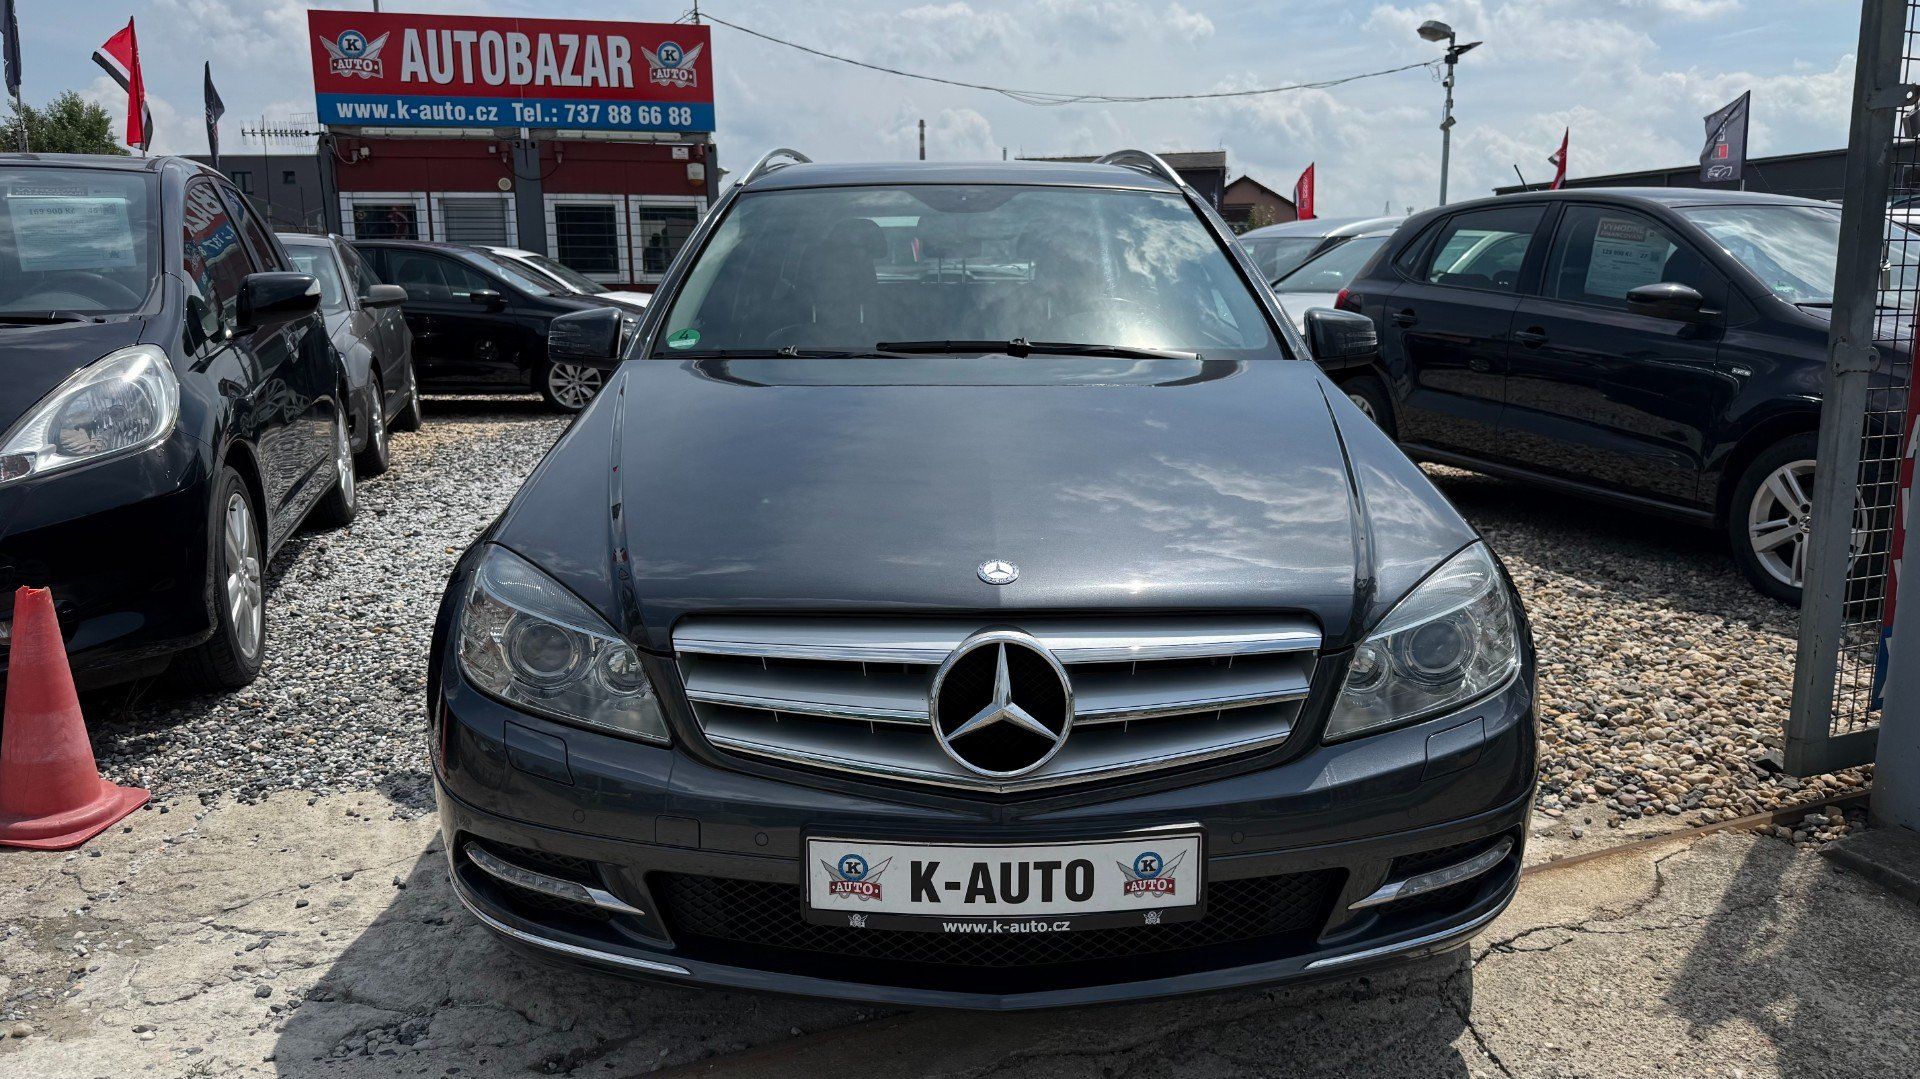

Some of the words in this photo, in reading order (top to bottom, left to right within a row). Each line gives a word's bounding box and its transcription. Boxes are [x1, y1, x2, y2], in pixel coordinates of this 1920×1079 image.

[345, 39, 359, 51] K
[401, 28, 634, 88] AUTOBAZAR
[663, 50, 677, 61] K
[337, 59, 373, 72] AUTO
[656, 68, 688, 81] AUTO
[336, 100, 499, 121] www.k-auto.cz
[512, 102, 557, 123] Tel.:
[565, 104, 600, 123] 737
[608, 105, 631, 125] 88
[638, 105, 662, 125] 66
[668, 106, 692, 126] 88
[679, 329, 689, 340] 4
[845, 861, 861, 874] K
[1141, 859, 1157, 872] K
[910, 858, 1095, 905] K-AUTO
[1131, 879, 1167, 891] AUTO
[835, 882, 873, 895] AUTO
[943, 919, 1071, 934] www.k-auto.cz
